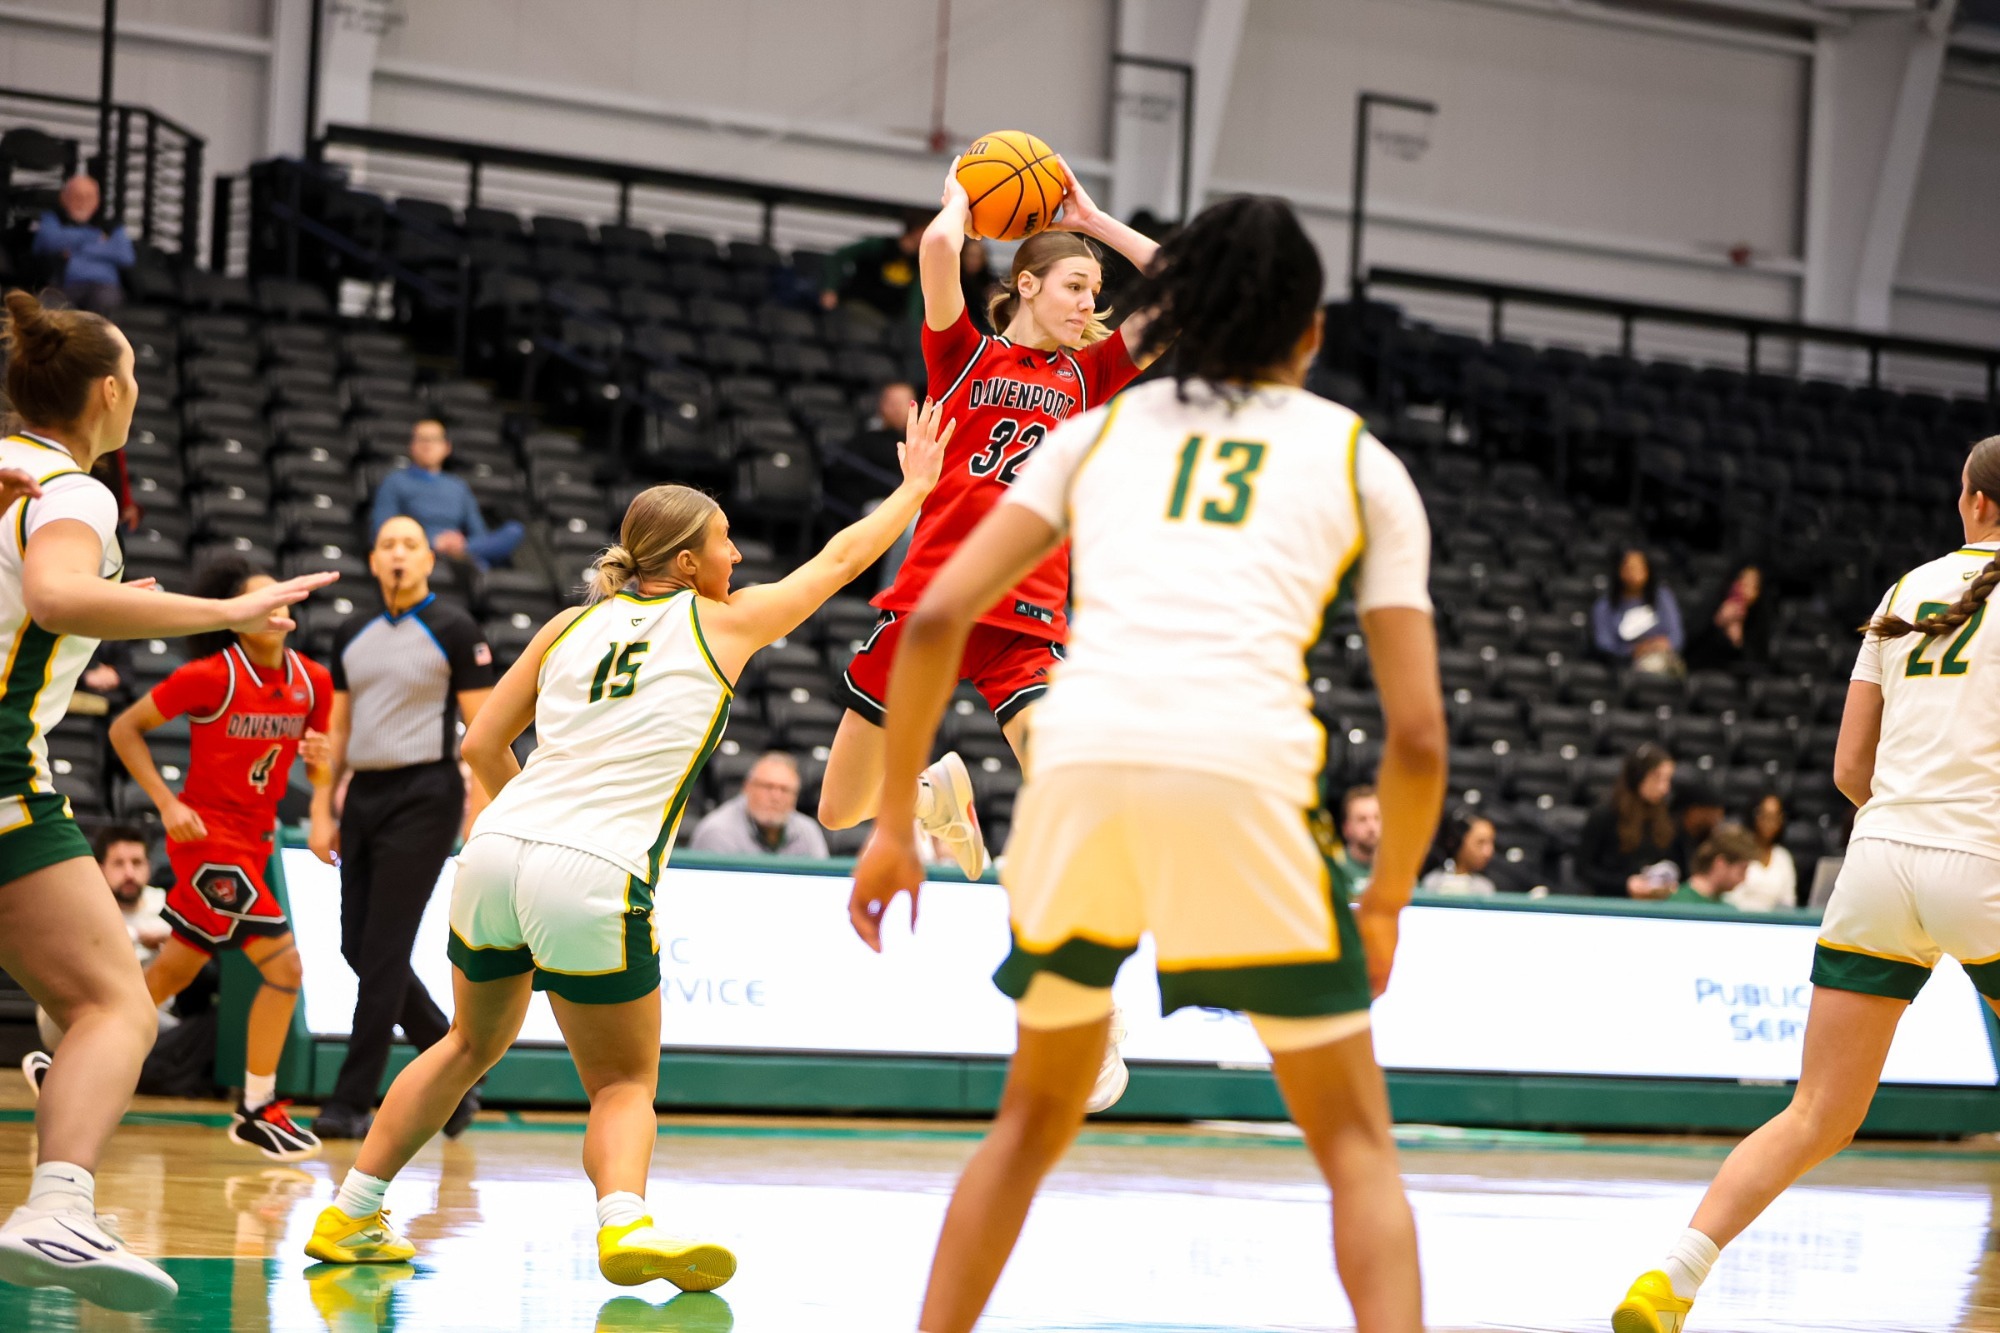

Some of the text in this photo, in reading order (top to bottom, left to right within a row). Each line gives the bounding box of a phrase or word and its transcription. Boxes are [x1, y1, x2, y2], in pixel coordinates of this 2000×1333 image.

[969, 418, 1047, 485] 32
[1165, 434, 1269, 527] 13
[588, 641, 650, 703] 15
[1905, 601, 1988, 677] 22
[249, 744, 282, 794] 4
